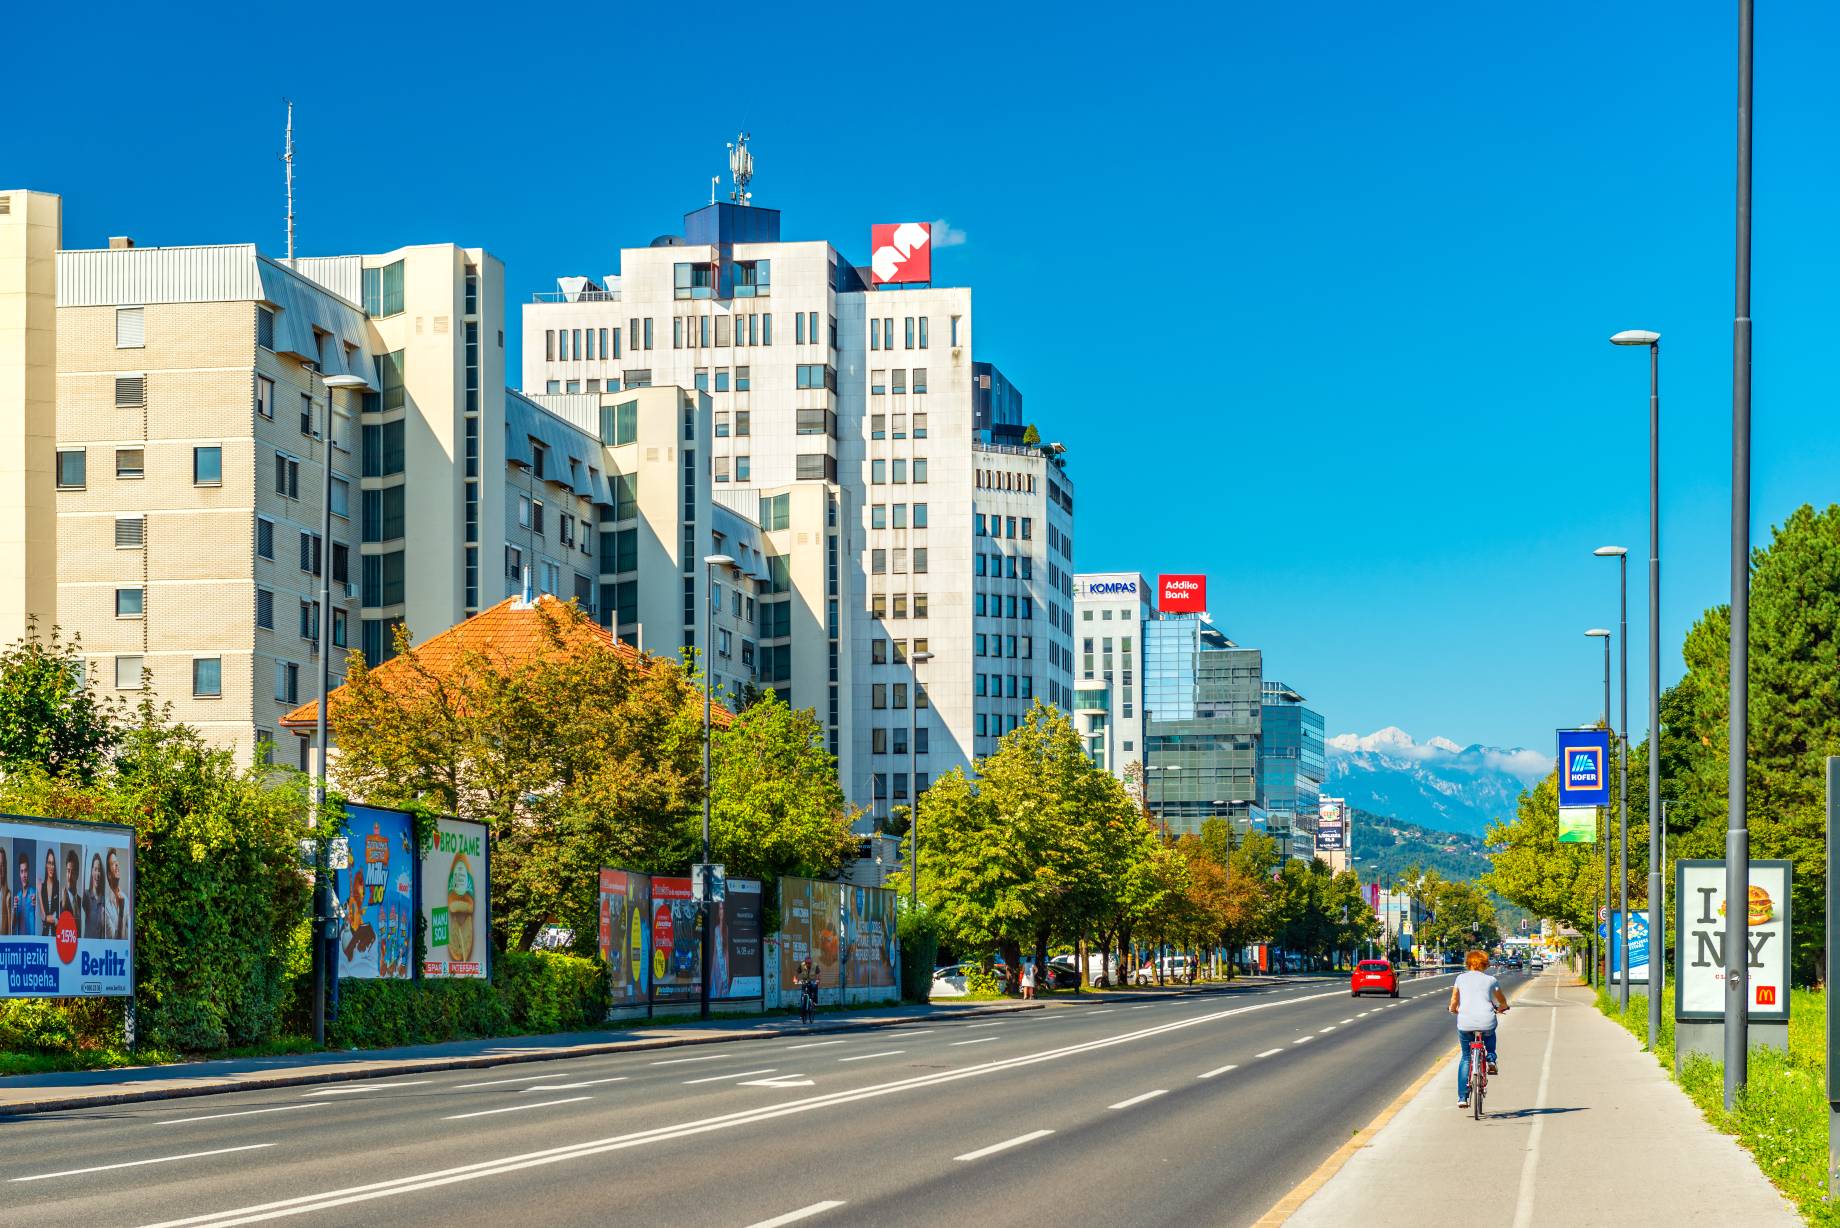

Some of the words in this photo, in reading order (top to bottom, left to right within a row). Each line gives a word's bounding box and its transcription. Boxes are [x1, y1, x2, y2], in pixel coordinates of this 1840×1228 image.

[1090, 583, 1136, 593] KOMPAS
[1165, 581, 1198, 590] Addiko
[1165, 591, 1189, 599] Bank
[459, 834, 480, 856] ZAME
[1697, 887, 1717, 924] I
[23, 948, 48, 969] jeziki
[81, 949, 126, 977] Berlitz
[10, 970, 21, 987] do
[23, 970, 57, 991] uspeha.
